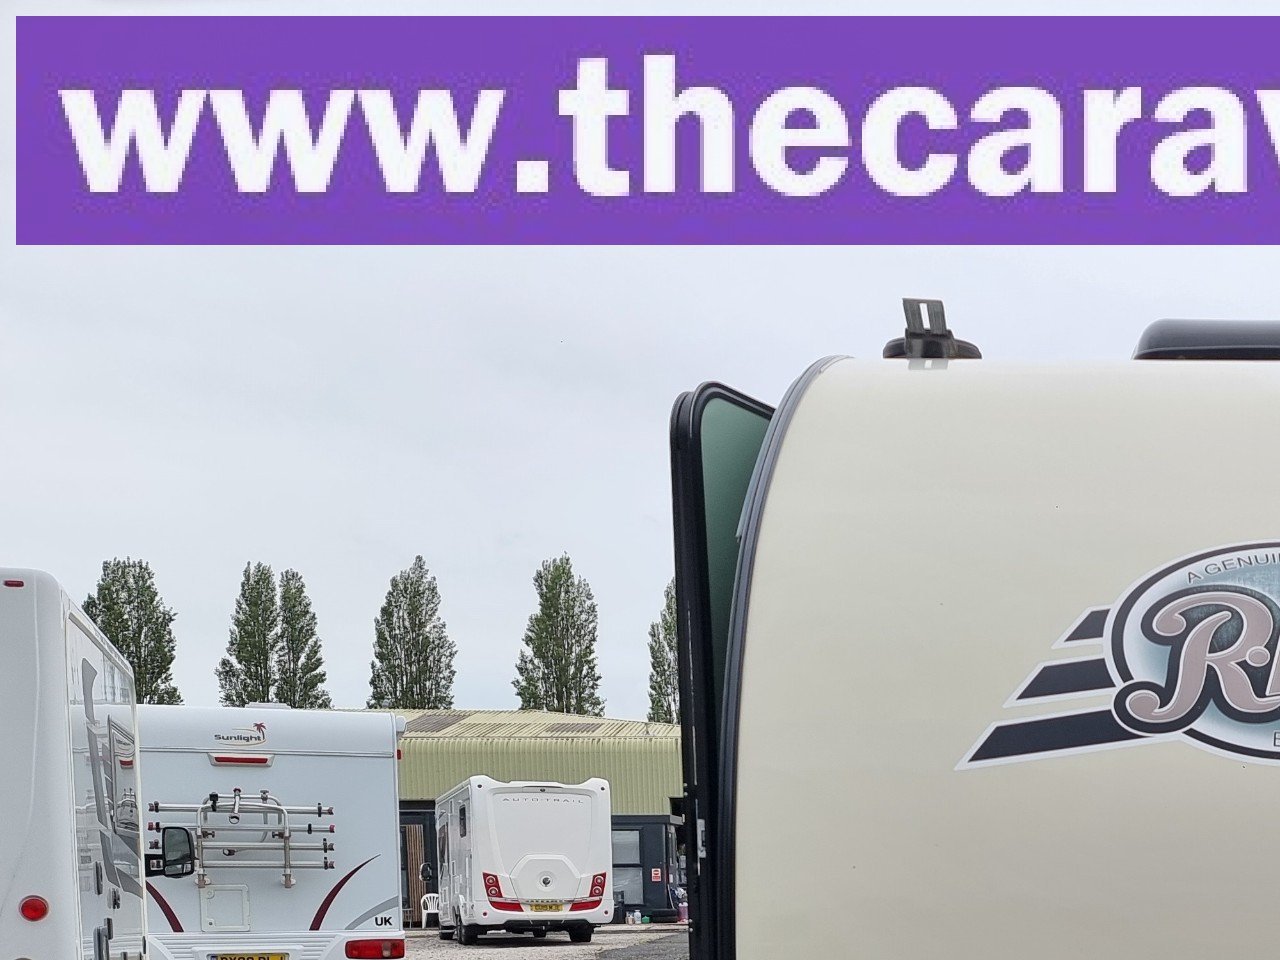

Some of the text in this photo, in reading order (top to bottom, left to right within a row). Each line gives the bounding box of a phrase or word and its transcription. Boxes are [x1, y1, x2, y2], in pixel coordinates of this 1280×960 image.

[1187, 570, 1201, 585] A
[214, 734, 261, 742] Sunlight
[374, 916, 393, 927] UK
